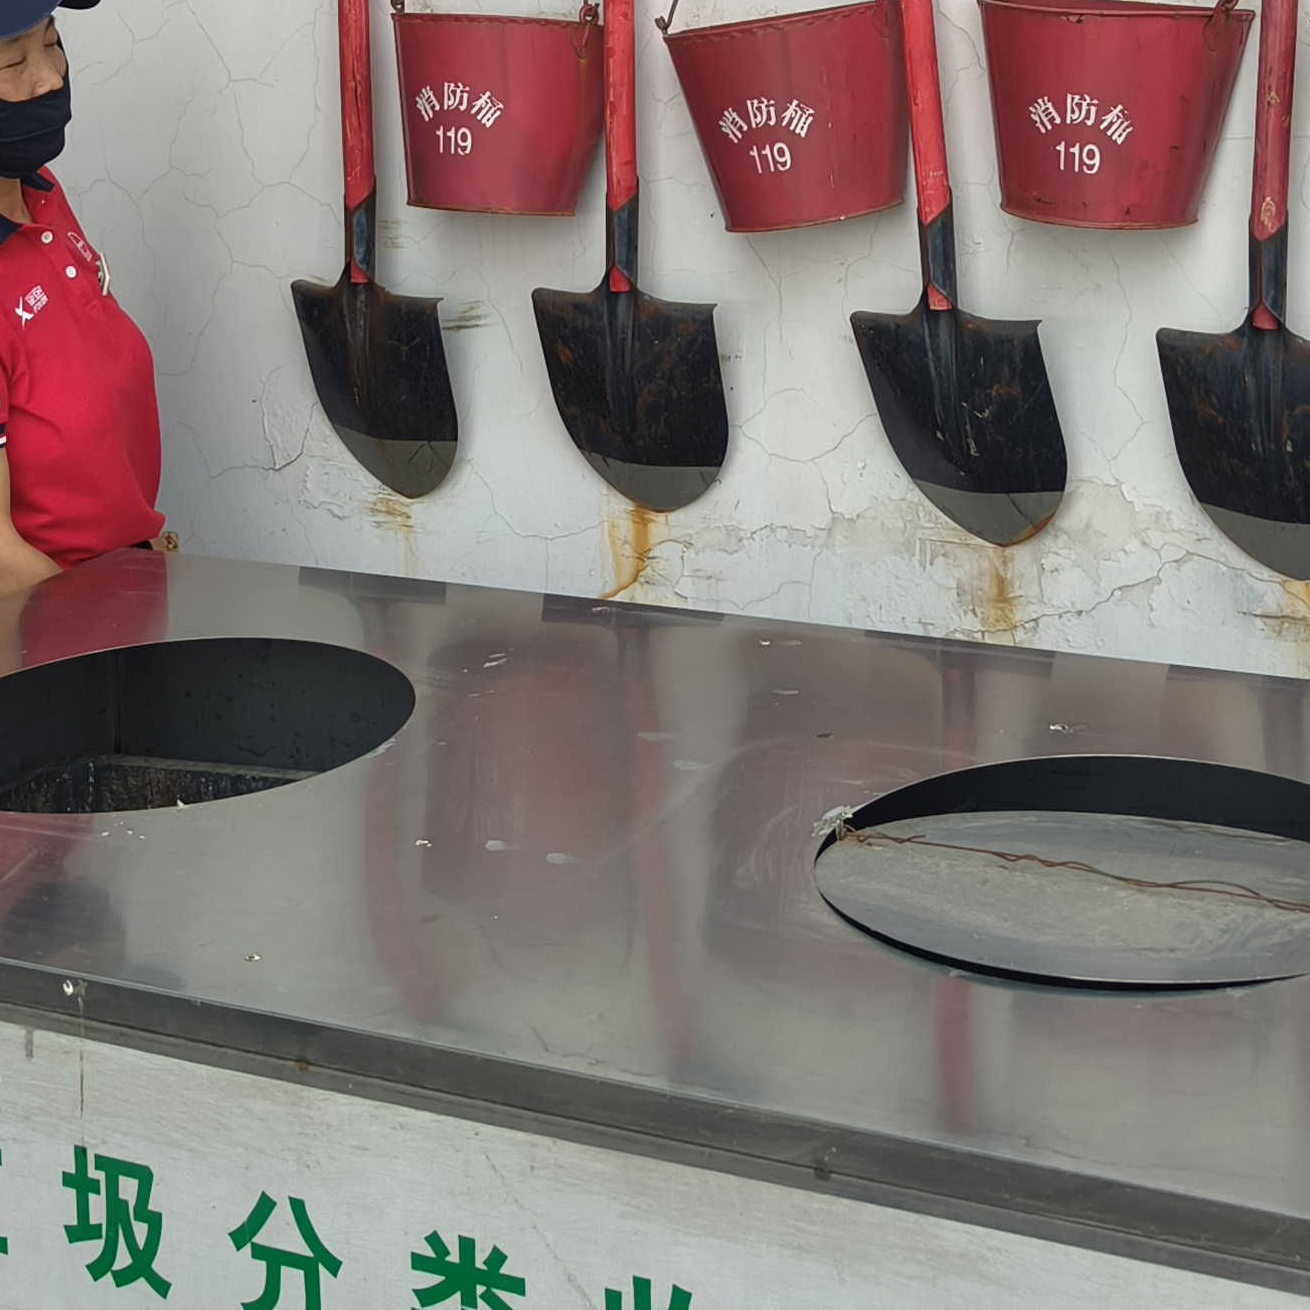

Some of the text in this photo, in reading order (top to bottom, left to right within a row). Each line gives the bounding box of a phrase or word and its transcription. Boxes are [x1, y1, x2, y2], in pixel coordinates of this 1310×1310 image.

[414, 80, 505, 129] 消防桶
[717, 95, 816, 144] 消防桶
[1027, 92, 1135, 146] 消防桶
[435, 124, 473, 157] 119
[748, 141, 792, 174] 119
[1054, 140, 1101, 175] 119
